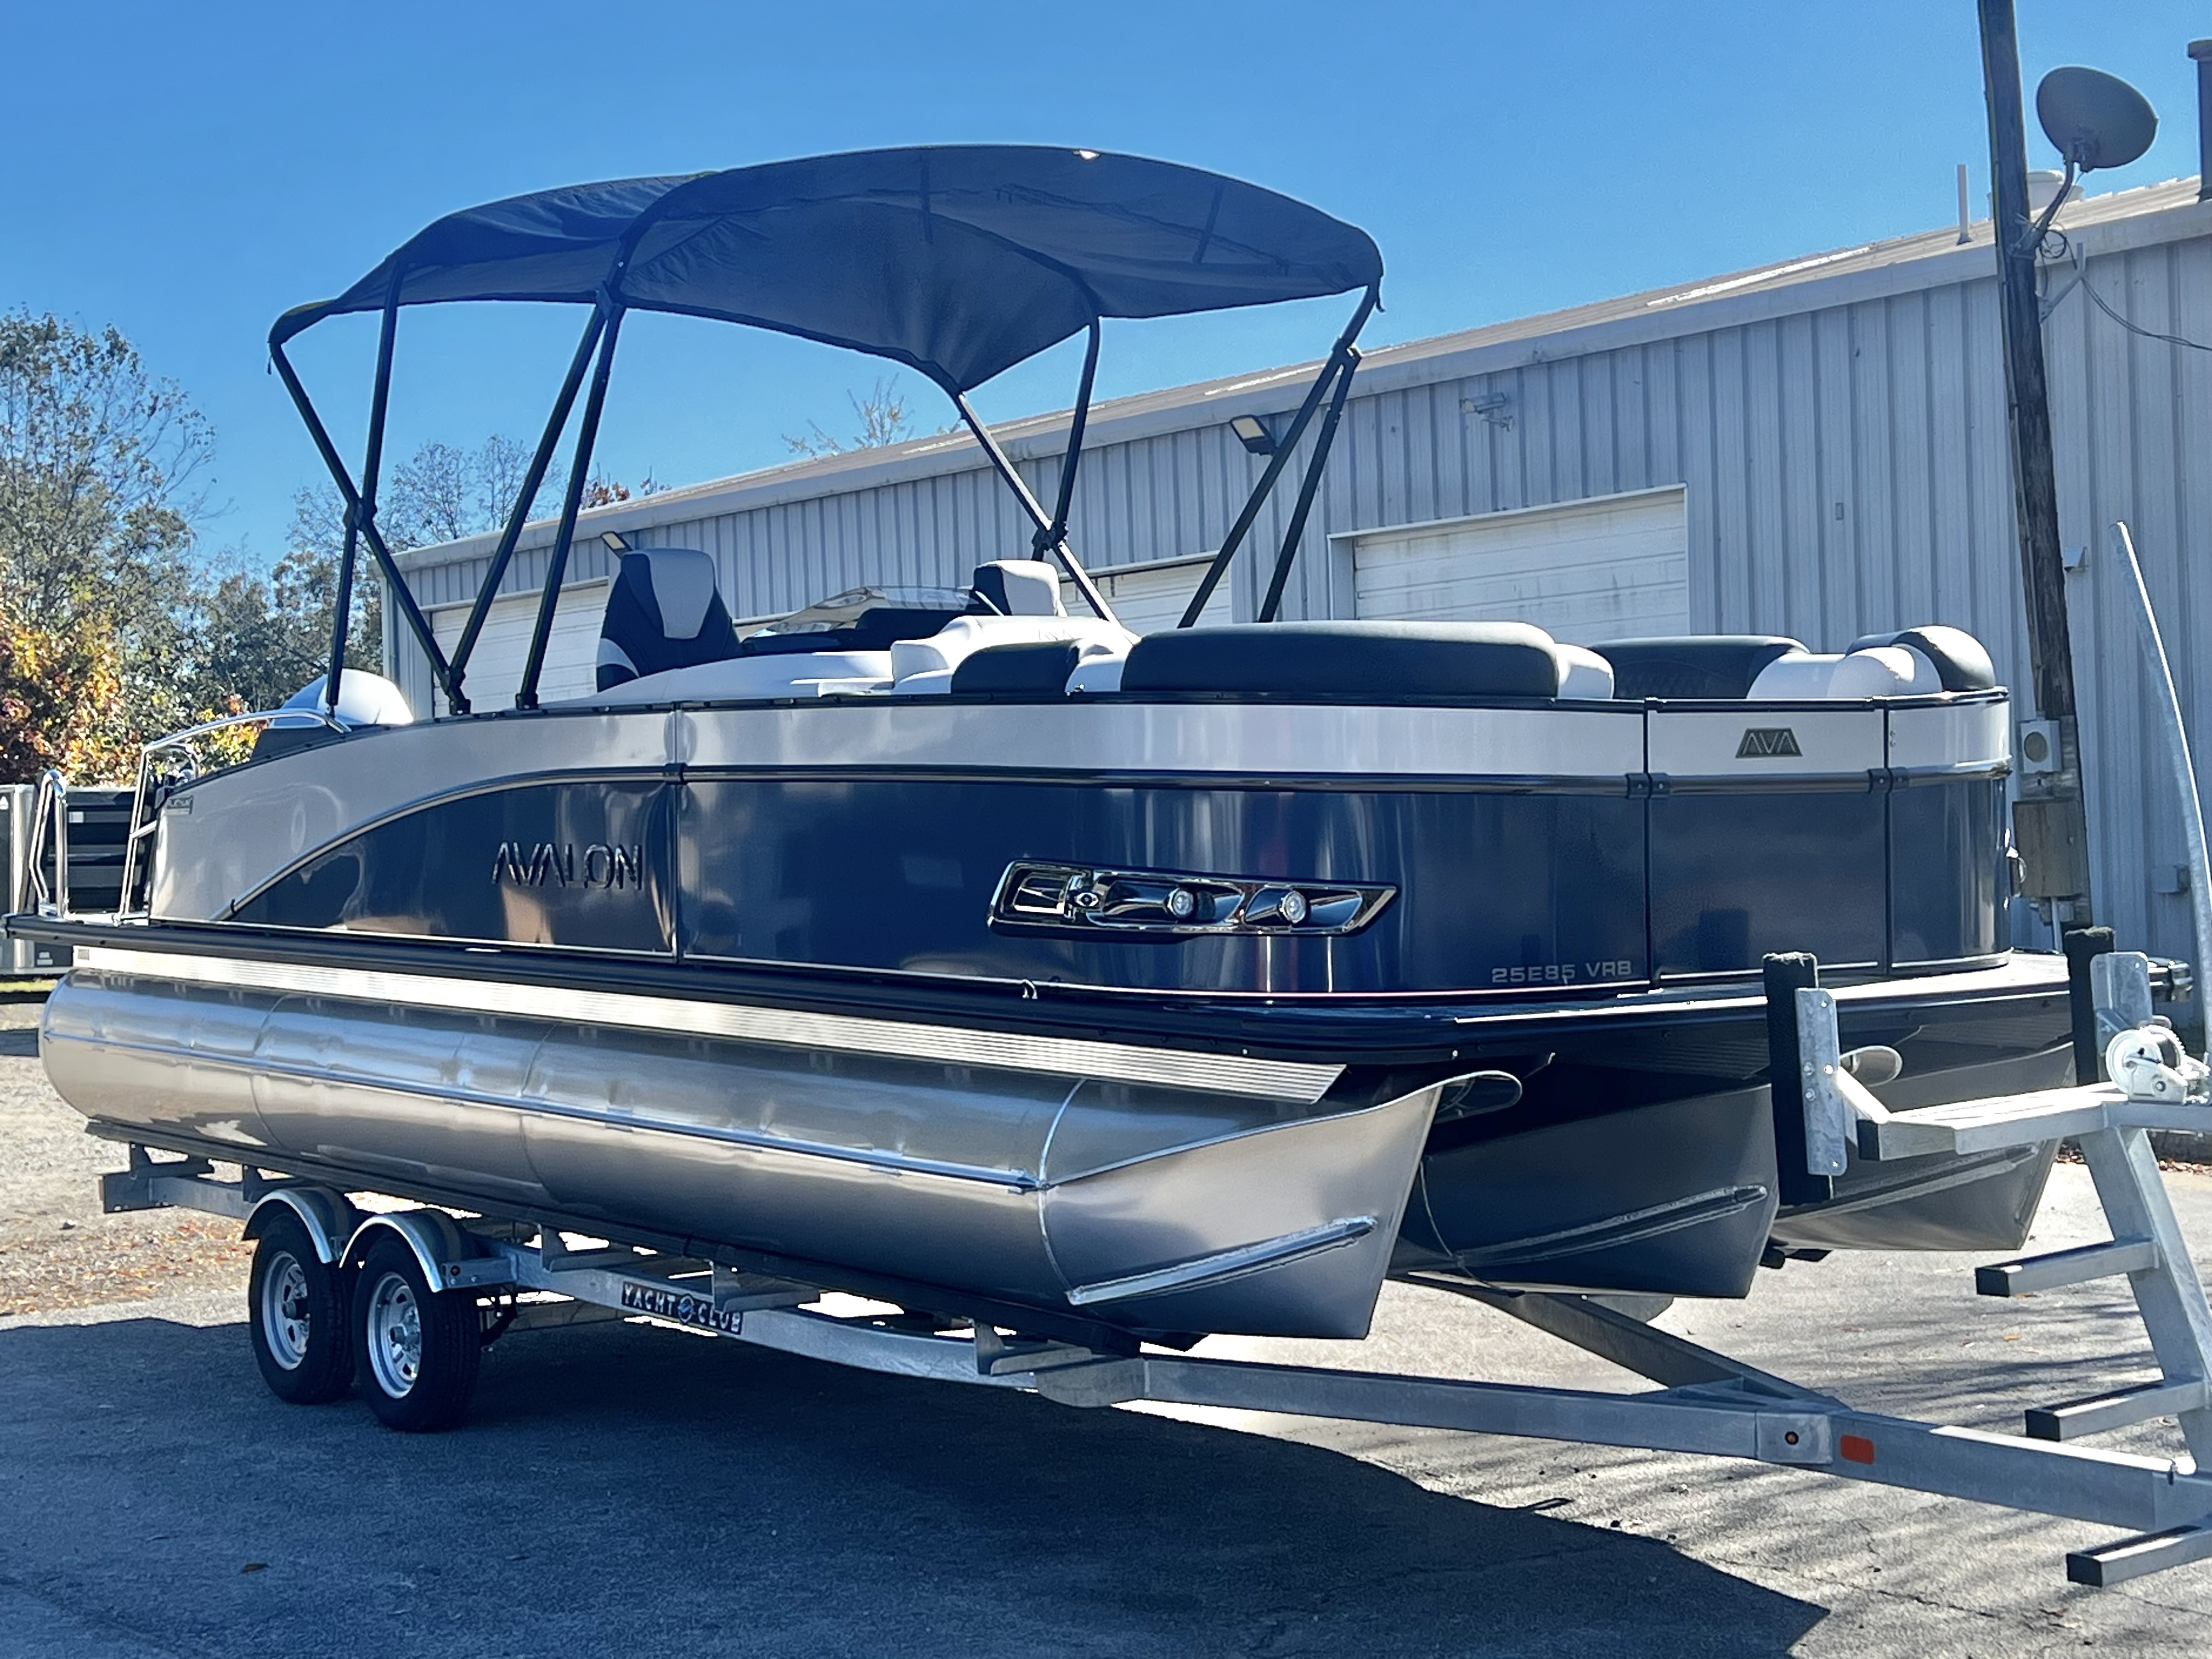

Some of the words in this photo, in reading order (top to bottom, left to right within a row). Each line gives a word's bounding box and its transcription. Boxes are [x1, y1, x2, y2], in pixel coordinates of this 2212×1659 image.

[1742, 731, 1797, 755] AVA
[492, 840, 642, 890] AVALON
[1585, 961, 1632, 977] VRB
[624, 1283, 676, 1315] YACHT
[698, 1303, 741, 1333] CLUB
